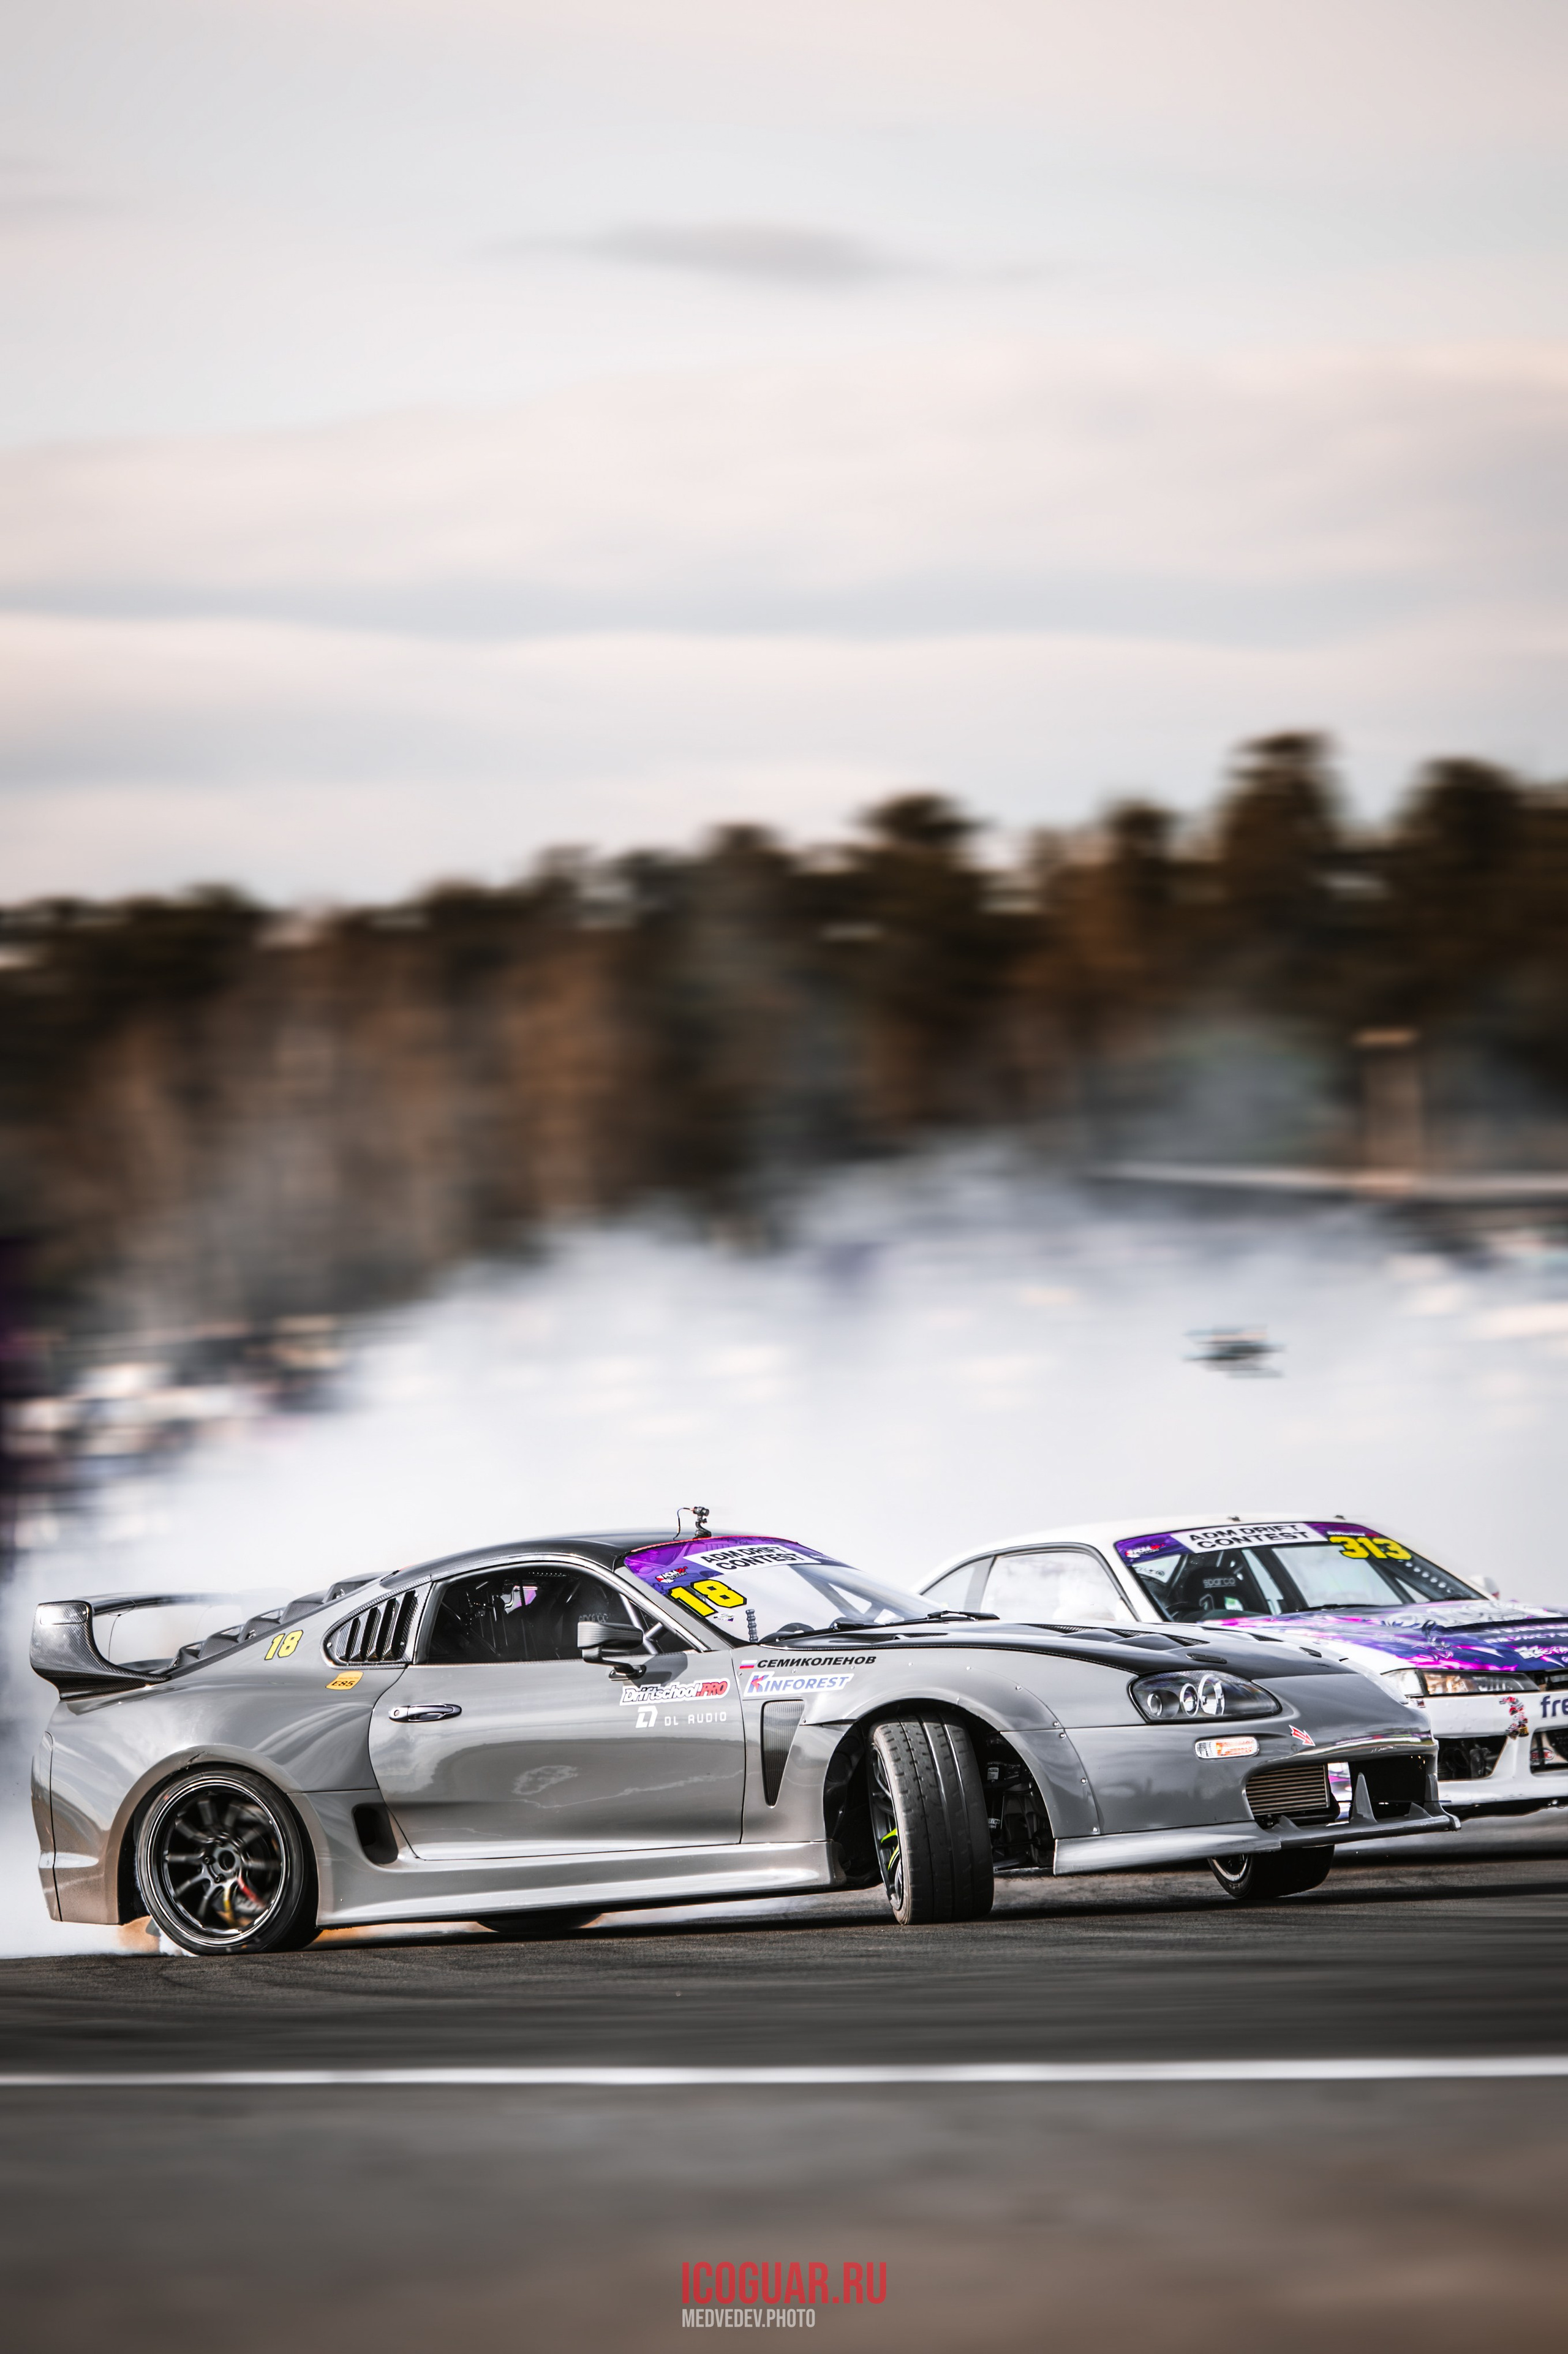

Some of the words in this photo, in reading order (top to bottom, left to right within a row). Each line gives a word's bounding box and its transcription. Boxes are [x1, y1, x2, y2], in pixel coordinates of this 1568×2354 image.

[1190, 1531, 1235, 1542] ADM
[1239, 1525, 1300, 1534] DRIFT
[1197, 1531, 1310, 1549] CONTEST
[700, 1550, 742, 1563] ADM
[738, 1547, 788, 1555] DRIFT
[1329, 1536, 1412, 1560] 313
[715, 1553, 804, 1569] CONTEST
[1203, 1577, 1236, 1588] sparco
[668, 1579, 747, 1617] 18
[264, 1629, 304, 1661] 18
[757, 1656, 876, 1668] СЕМИКОЛЕНОВ
[623, 1681, 728, 1703] Driftschool.PRO
[747, 1675, 850, 1693] KINFOREST
[665, 1716, 679, 1726] DL
[688, 1711, 726, 1724] AUDIO
